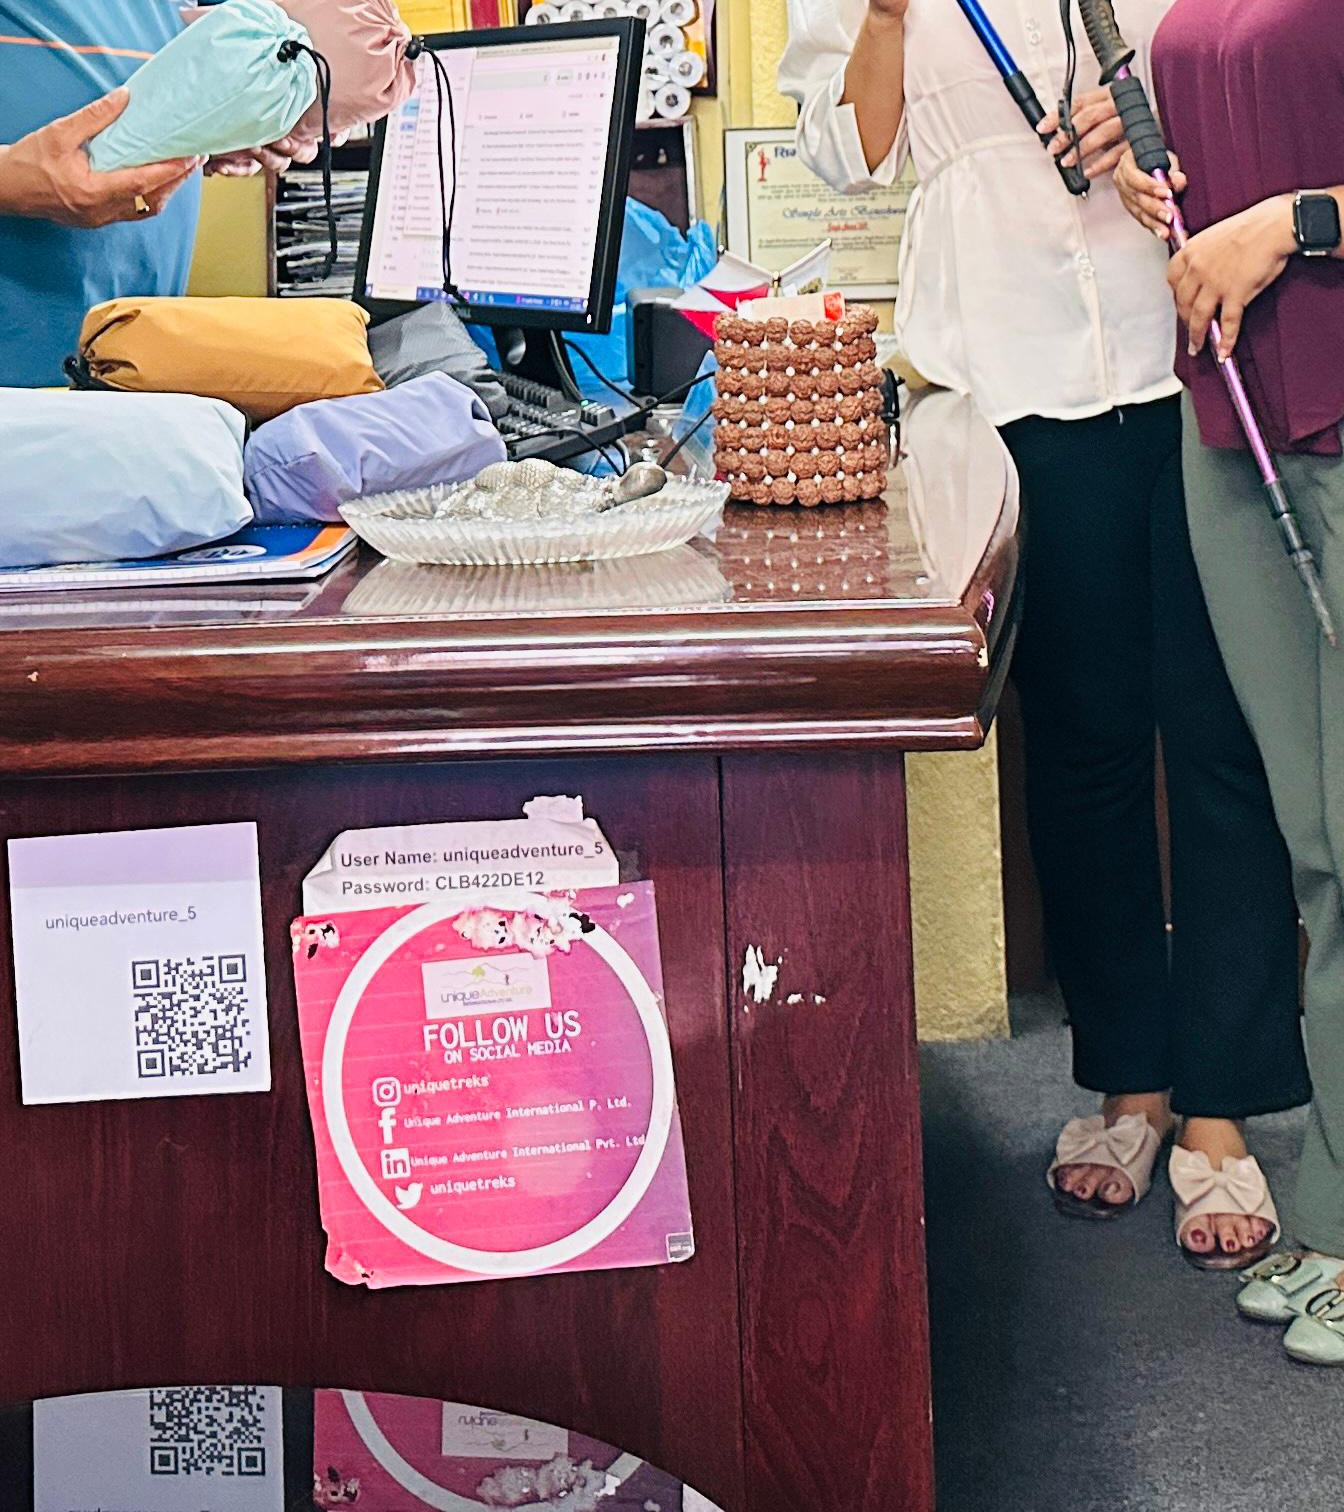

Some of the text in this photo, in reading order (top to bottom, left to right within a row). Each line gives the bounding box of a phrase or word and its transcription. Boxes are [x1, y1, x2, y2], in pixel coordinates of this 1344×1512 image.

[340, 841, 605, 868] User Name: uniqueadventure_5
[341, 870, 545, 896] Password: CLB422DE12
[45, 905, 198, 932] uniqueadventure_5
[423, 1009, 583, 1052] FOLLOW US
[443, 1038, 572, 1065] ON SOCIAL MEDIA
[403, 1074, 490, 1097] uniquetreks
[403, 1096, 633, 1130] Unique Adventure International P. Ltd.
[409, 1154, 449, 1169] Unique
[452, 1148, 508, 1164] Adventure
[512, 1140, 592, 1159] International
[595, 1137, 621, 1151] Pvt.
[429, 1175, 517, 1197] uniquetreks
